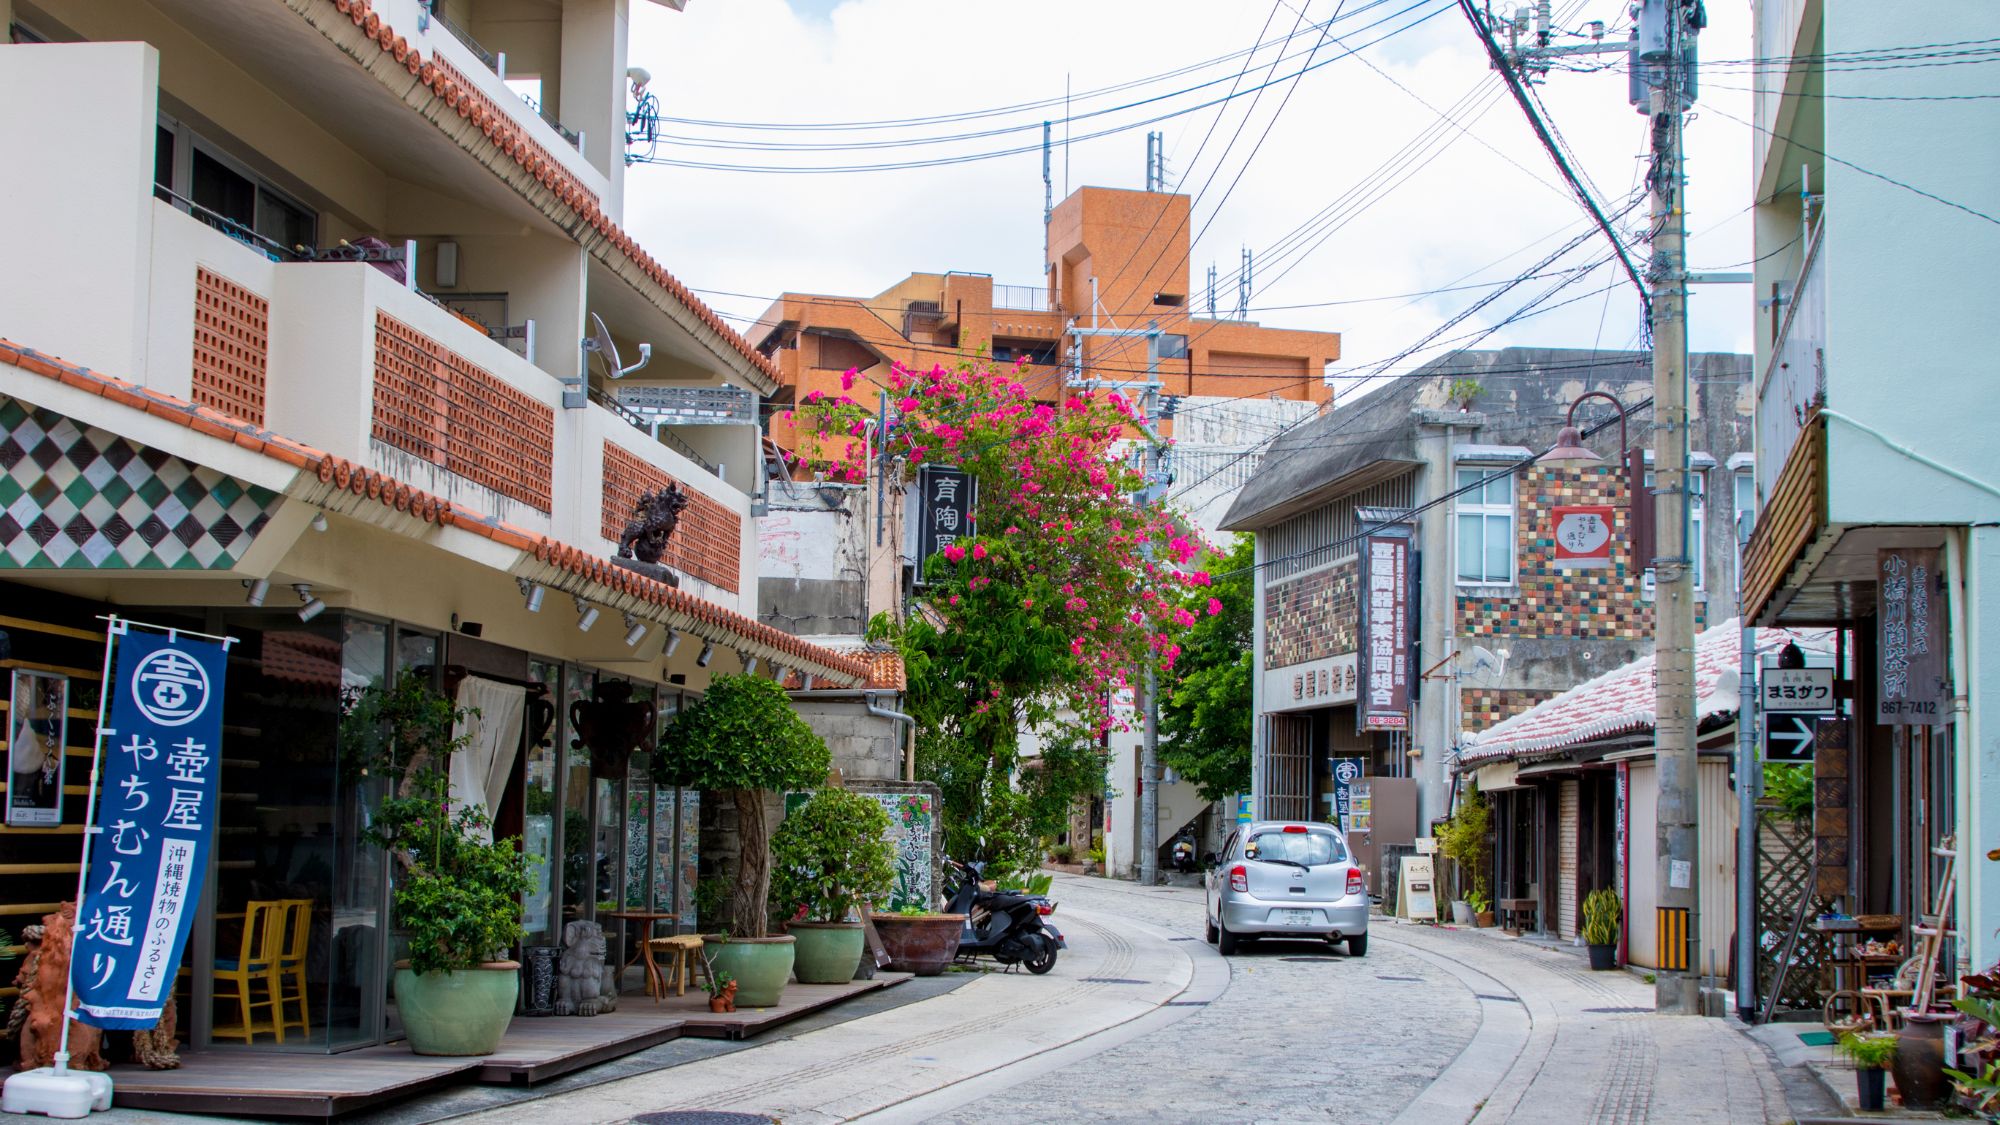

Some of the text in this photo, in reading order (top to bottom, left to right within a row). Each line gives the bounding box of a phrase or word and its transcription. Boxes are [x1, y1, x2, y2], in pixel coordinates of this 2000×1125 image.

[1881, 701, 1937, 715] 867-7412
[160, 737, 210, 831] 壺屋
[85, 734, 159, 990] やちむん通り
[138, 845, 187, 994] 沖縄焼物のふるさと
